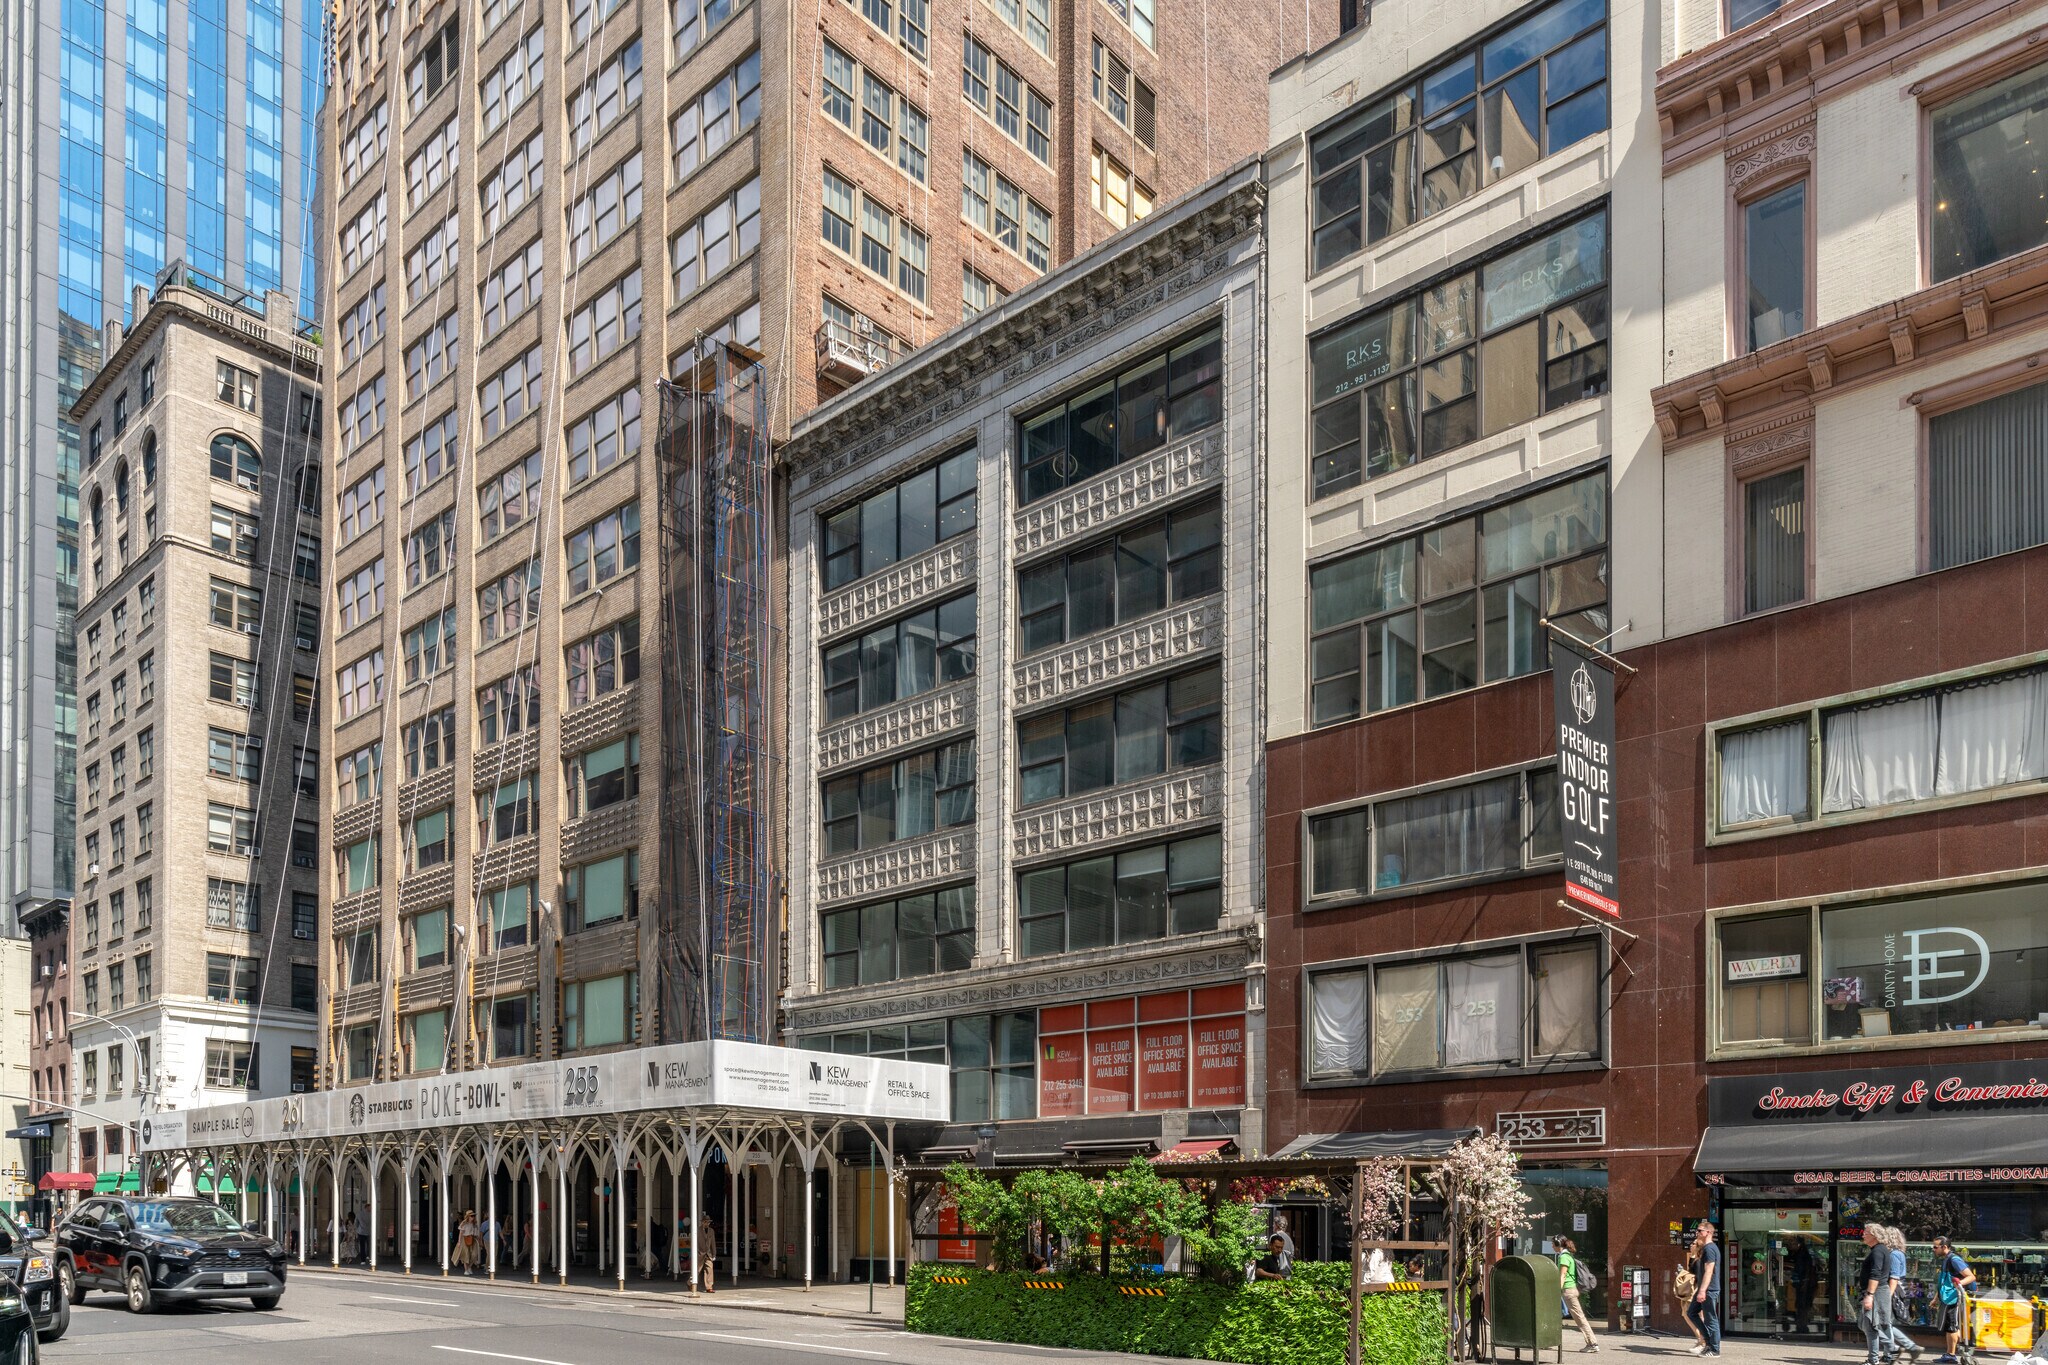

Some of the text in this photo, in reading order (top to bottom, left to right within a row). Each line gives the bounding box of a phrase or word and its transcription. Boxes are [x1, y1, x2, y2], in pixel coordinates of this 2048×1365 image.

[1520, 256, 1564, 288] RKS
[1346, 338, 1381, 366] RKS
[1335, 381, 1349, 394] 212
[1354, 373, 1367, 385] 951
[1561, 724, 1608, 765] PREMIER
[1562, 750, 1609, 794] INDOOR
[1563, 781, 1609, 835] GOLF
[1731, 956, 1799, 973] WAVERLY
[1884, 933, 1896, 1008] DAINTY HOME
[1396, 1007, 1424, 1025] 253
[1467, 999, 1498, 1018] 253
[1146, 1034, 1183, 1048] FULL FLOOR
[1200, 1028, 1240, 1043] FULL FLOOR
[1095, 1040, 1130, 1053] FULL FLOOR
[1197, 1041, 1243, 1057] OFFICE SPACE
[1056, 1050, 1071, 1059] KEW
[1092, 1052, 1133, 1066] OFFICE SPACE
[1143, 1047, 1186, 1062] OFFICE SPACE
[665, 1061, 688, 1079] KEW
[1147, 1061, 1182, 1074] AVAILABLE
[1201, 1055, 1239, 1070] AVAILABLE
[724, 1067, 790, 1078] space@kewmanagement.com
[827, 1065, 850, 1079] KEW
[1096, 1065, 1129, 1078] AVAILABLE
[566, 1065, 600, 1095] 255
[665, 1076, 708, 1090] MANAGEMENT
[729, 1075, 790, 1085] www.kewmanagement.com
[827, 1078, 868, 1088] MANAGEMENT
[888, 1080, 908, 1089] RETAIL
[1044, 1081, 1054, 1090] 212
[1068, 1079, 1082, 1088] 3346
[888, 1089, 930, 1100] OFFICE SPACE
[1759, 1086, 1840, 1111] Smoke
[1842, 1082, 1895, 1112] Gift
[1901, 1079, 1928, 1104] &
[368, 1099, 413, 1115] STARBUCKS
[192, 1120, 219, 1133] SAMPLE
[221, 1117, 239, 1131] SALE
[1503, 1119, 1546, 1140] 253
[1705, 1174, 1725, 1184] 251
[1839, 1227, 1865, 1236] OPEN
